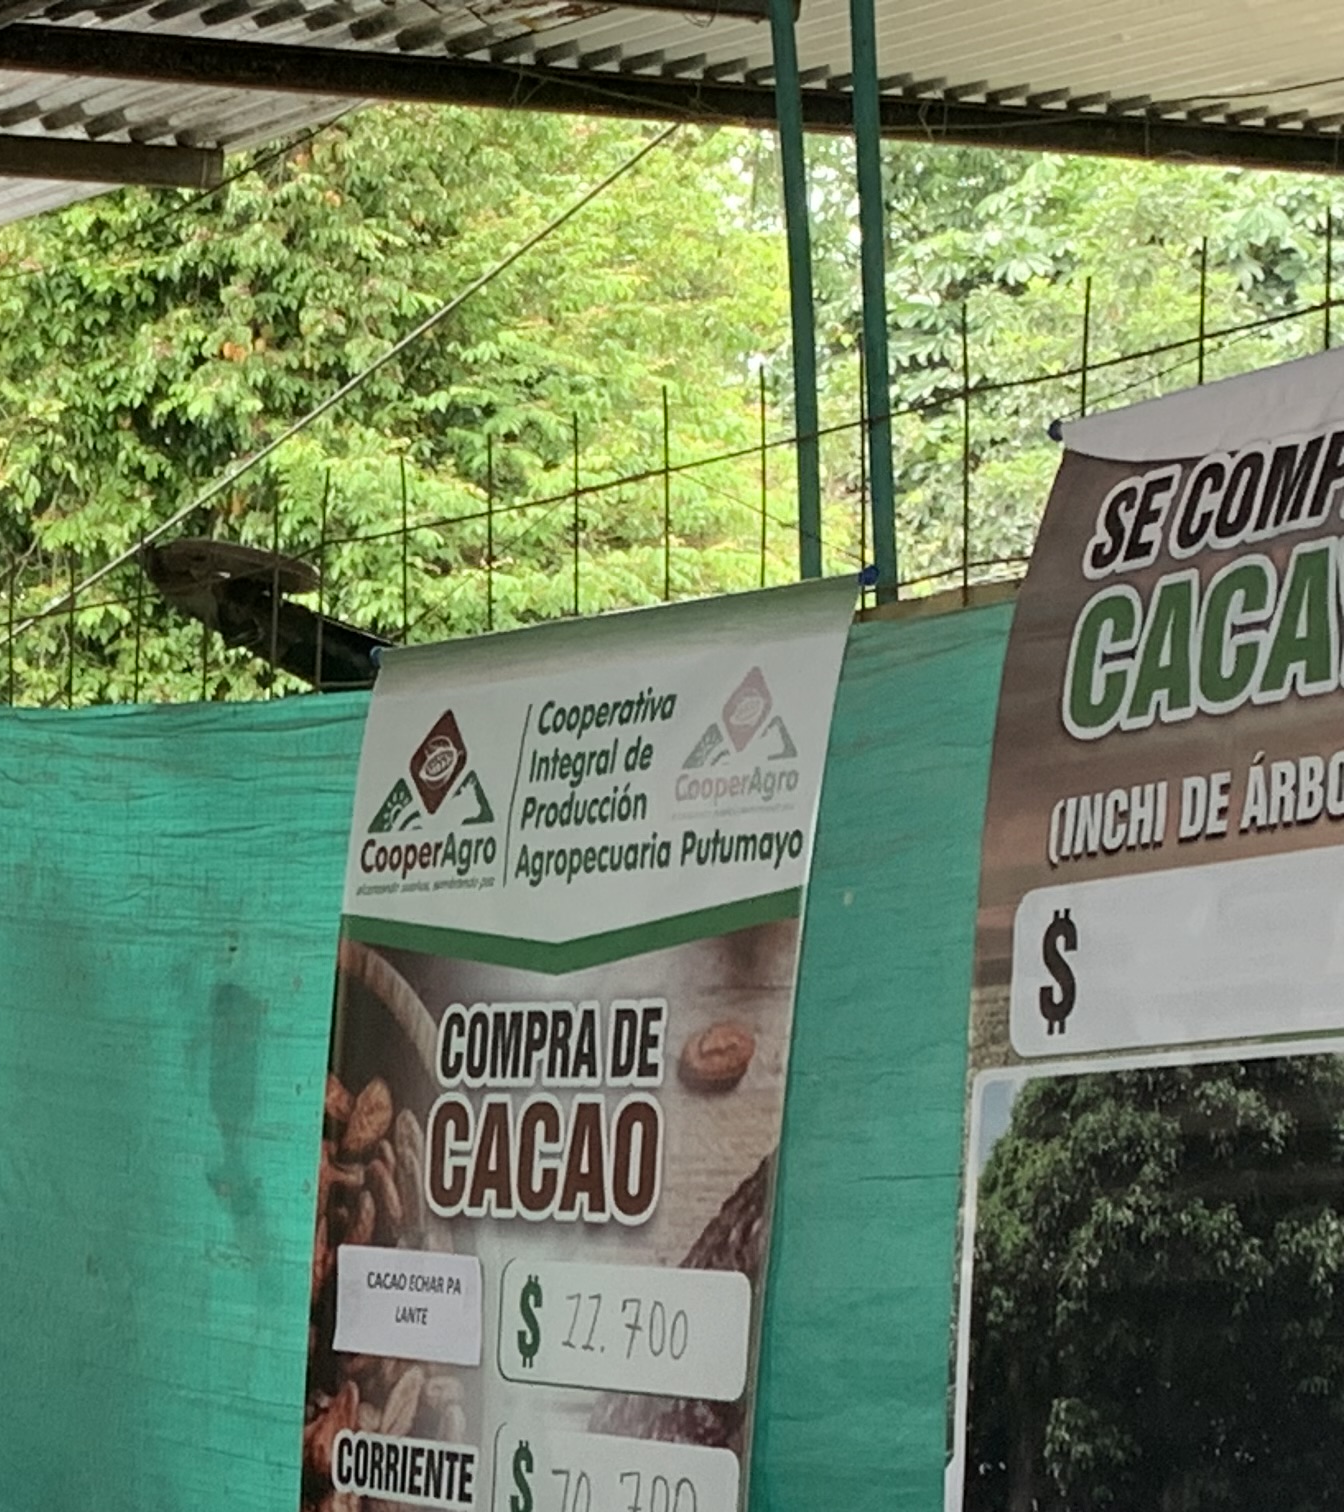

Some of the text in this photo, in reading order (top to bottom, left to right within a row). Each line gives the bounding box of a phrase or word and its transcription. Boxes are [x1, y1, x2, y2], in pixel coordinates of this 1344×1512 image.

[1089, 473, 1176, 572] SE
[1067, 544, 1340, 732] CACA
[537, 686, 679, 741] Cooperativa
[528, 737, 654, 789] Integral de
[675, 765, 800, 807] CooperAgro
[520, 784, 648, 831] Producción
[1048, 781, 1168, 866] (INCHI
[1178, 771, 1232, 841] DE
[360, 831, 497, 880] CooperAgro
[515, 828, 804, 888] Agropecuaria Putumayo
[440, 1005, 664, 1080] COMPRA DE
[429, 1098, 660, 1216] CACAO
[367, 1271, 407, 1291] CACAO
[445, 1275, 462, 1295] PA
[395, 1305, 428, 1326] LANTE
[516, 1273, 544, 1369] $
[334, 1435, 476, 1504] CORRIENTE
